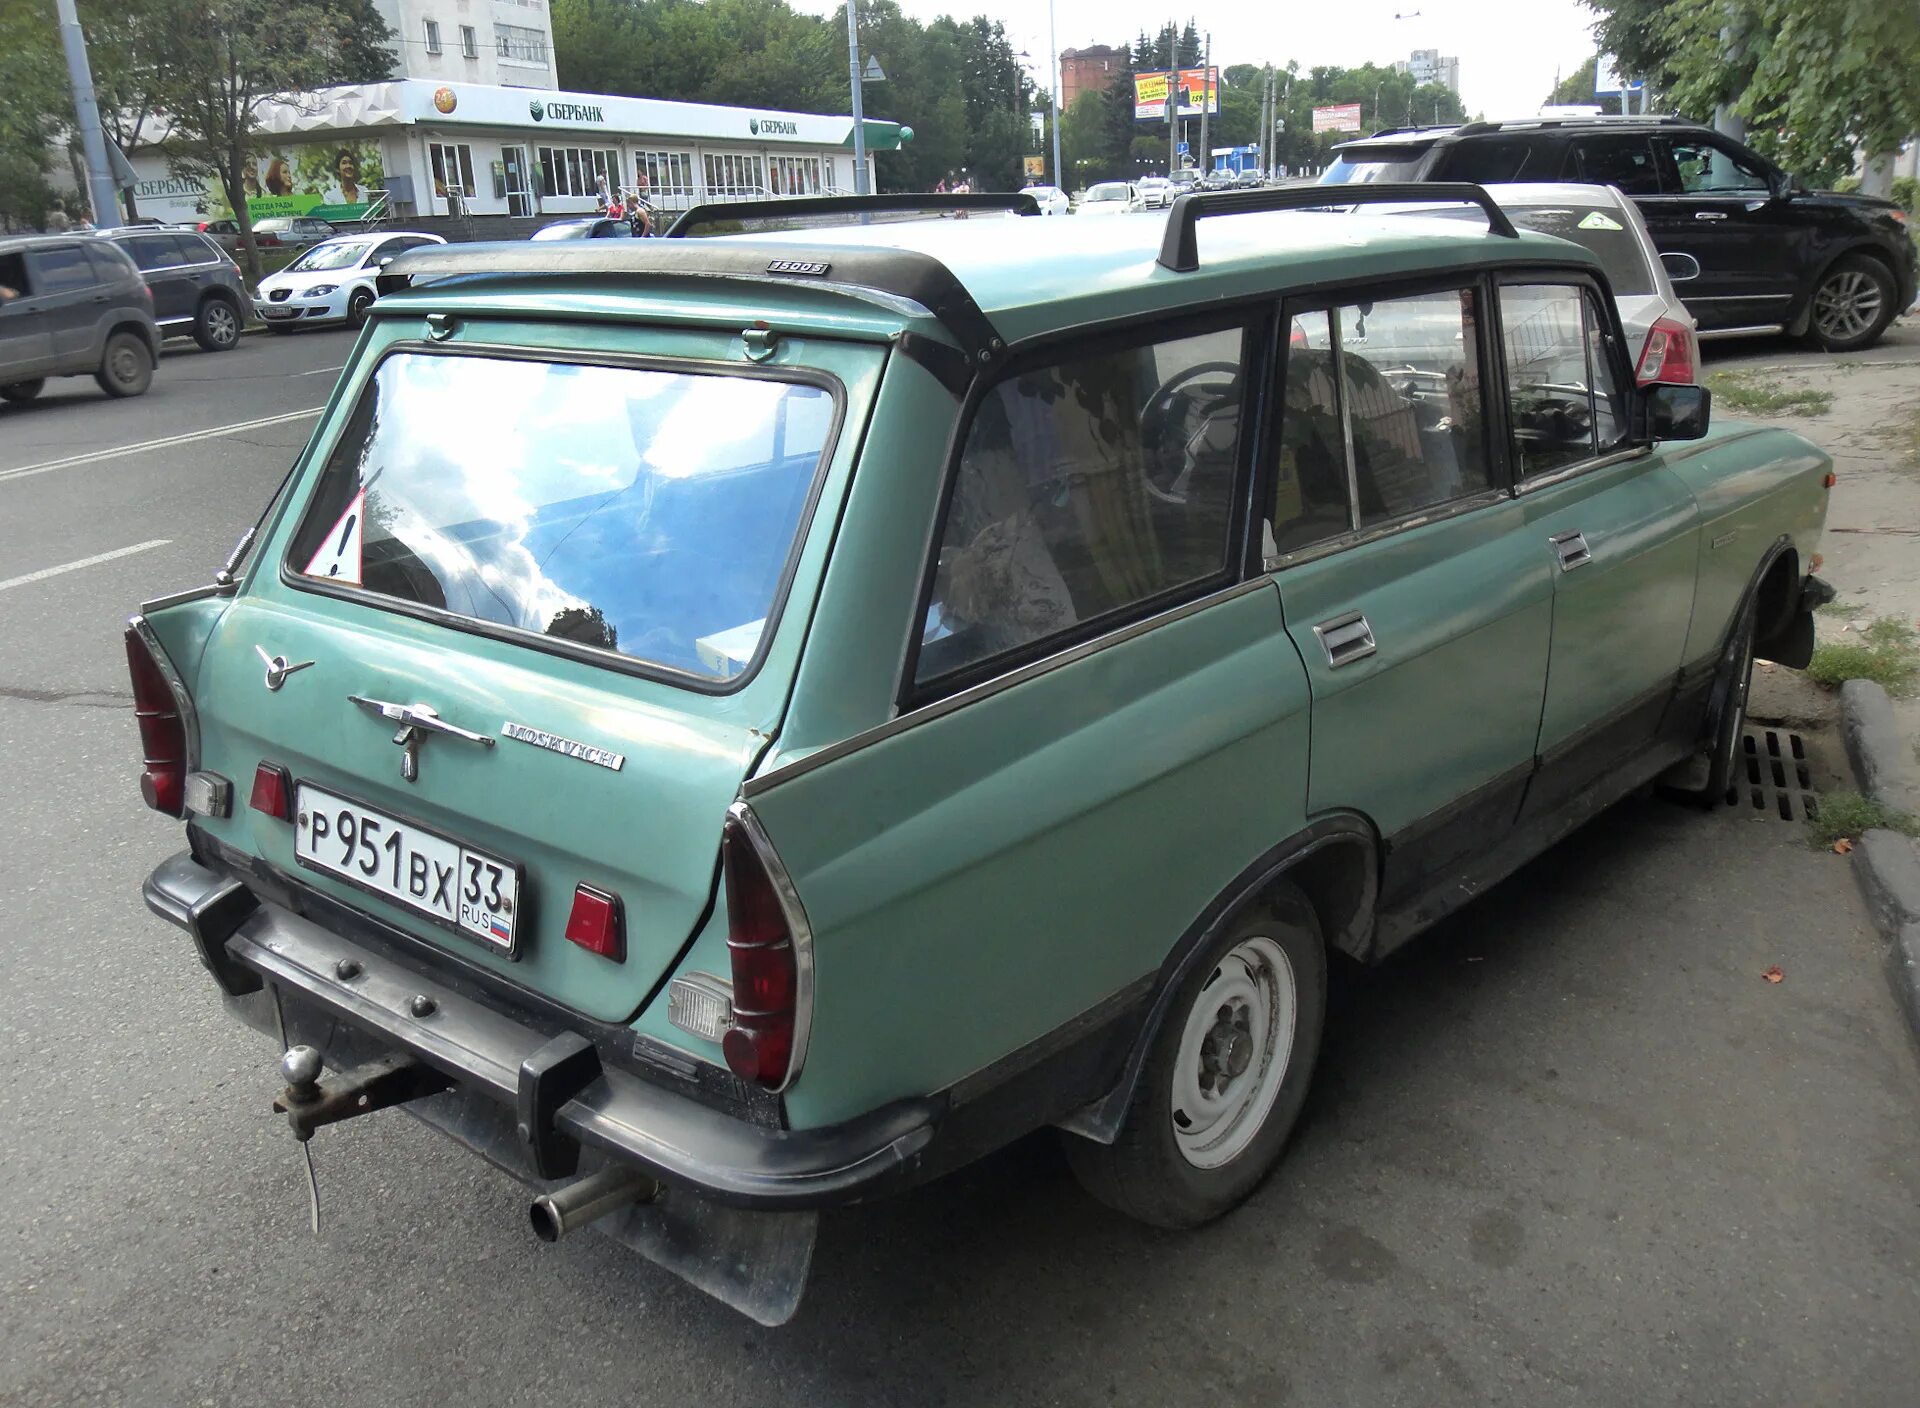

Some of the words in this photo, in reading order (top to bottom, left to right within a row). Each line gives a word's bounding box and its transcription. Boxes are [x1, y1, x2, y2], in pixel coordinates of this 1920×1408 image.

[547, 102, 604, 123] СБЕРБАНК
[760, 119, 798, 135] СБЕРБАНК
[250, 202, 275, 211] ВСЕГДА
[275, 201, 293, 209] РАДЫ
[252, 210, 275, 219] НОВОЙ
[773, 261, 824, 273] 1500S
[508, 723, 616, 768] MOSKVICH
[464, 854, 503, 914] 33
[461, 903, 490, 930] RUS
